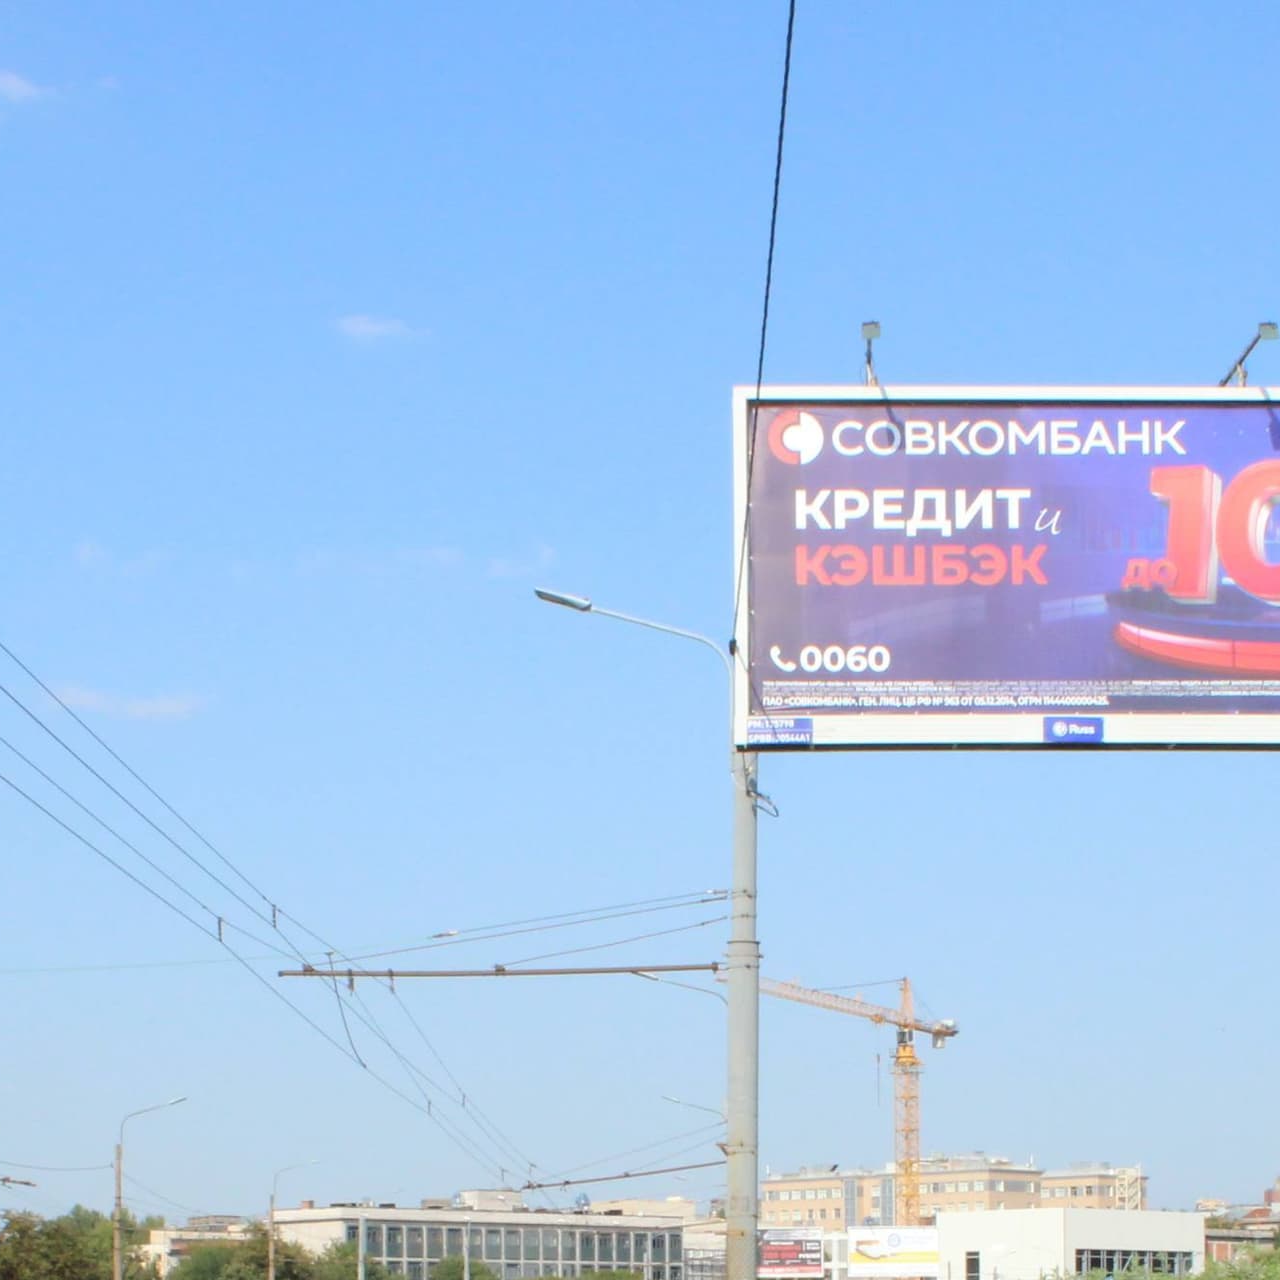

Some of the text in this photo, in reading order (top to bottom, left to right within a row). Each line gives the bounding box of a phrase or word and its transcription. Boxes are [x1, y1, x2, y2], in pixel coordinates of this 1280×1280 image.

[832, 419, 1188, 456] СОВКОМБАНК
[795, 488, 1062, 536] КРЕДИТ и
[794, 545, 1048, 586] КЭШБЭК
[799, 645, 891, 672] 0060
[763, 696, 783, 706] ПАО
[917, 696, 932, 706] РФ
[960, 696, 973, 706] ОТ
[1068, 723, 1096, 735] Russ
